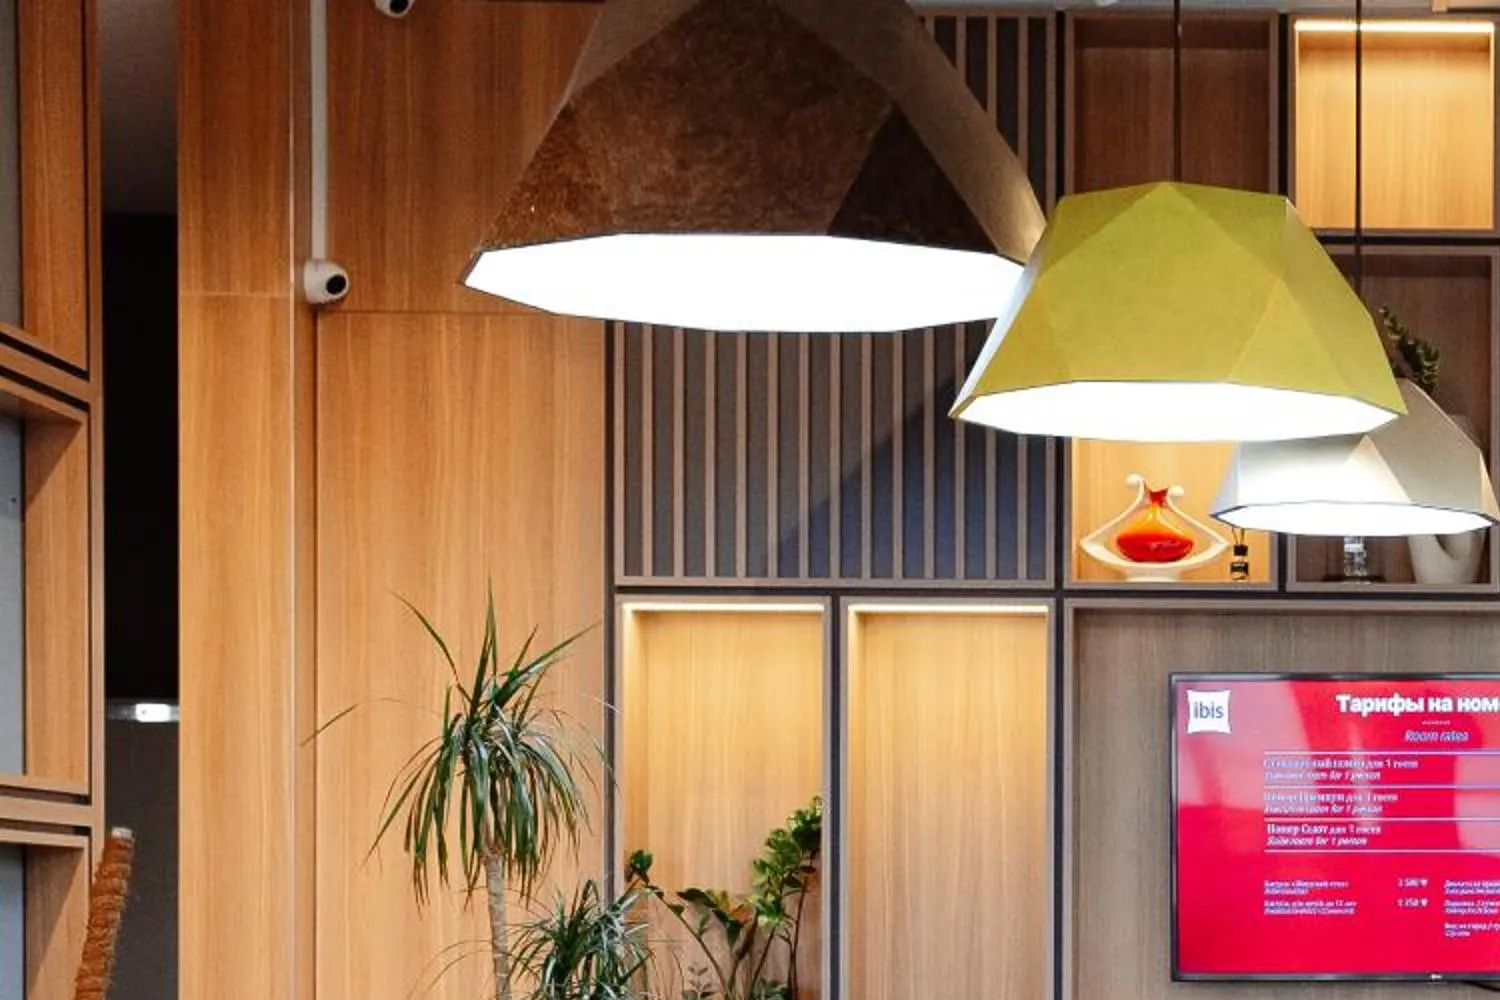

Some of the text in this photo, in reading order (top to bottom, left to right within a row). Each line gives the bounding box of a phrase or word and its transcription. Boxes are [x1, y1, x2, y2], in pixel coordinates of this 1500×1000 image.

[1193, 701, 1224, 719] ibis
[1336, 693, 1425, 717] Тарифы
[1428, 697, 1453, 713] на
